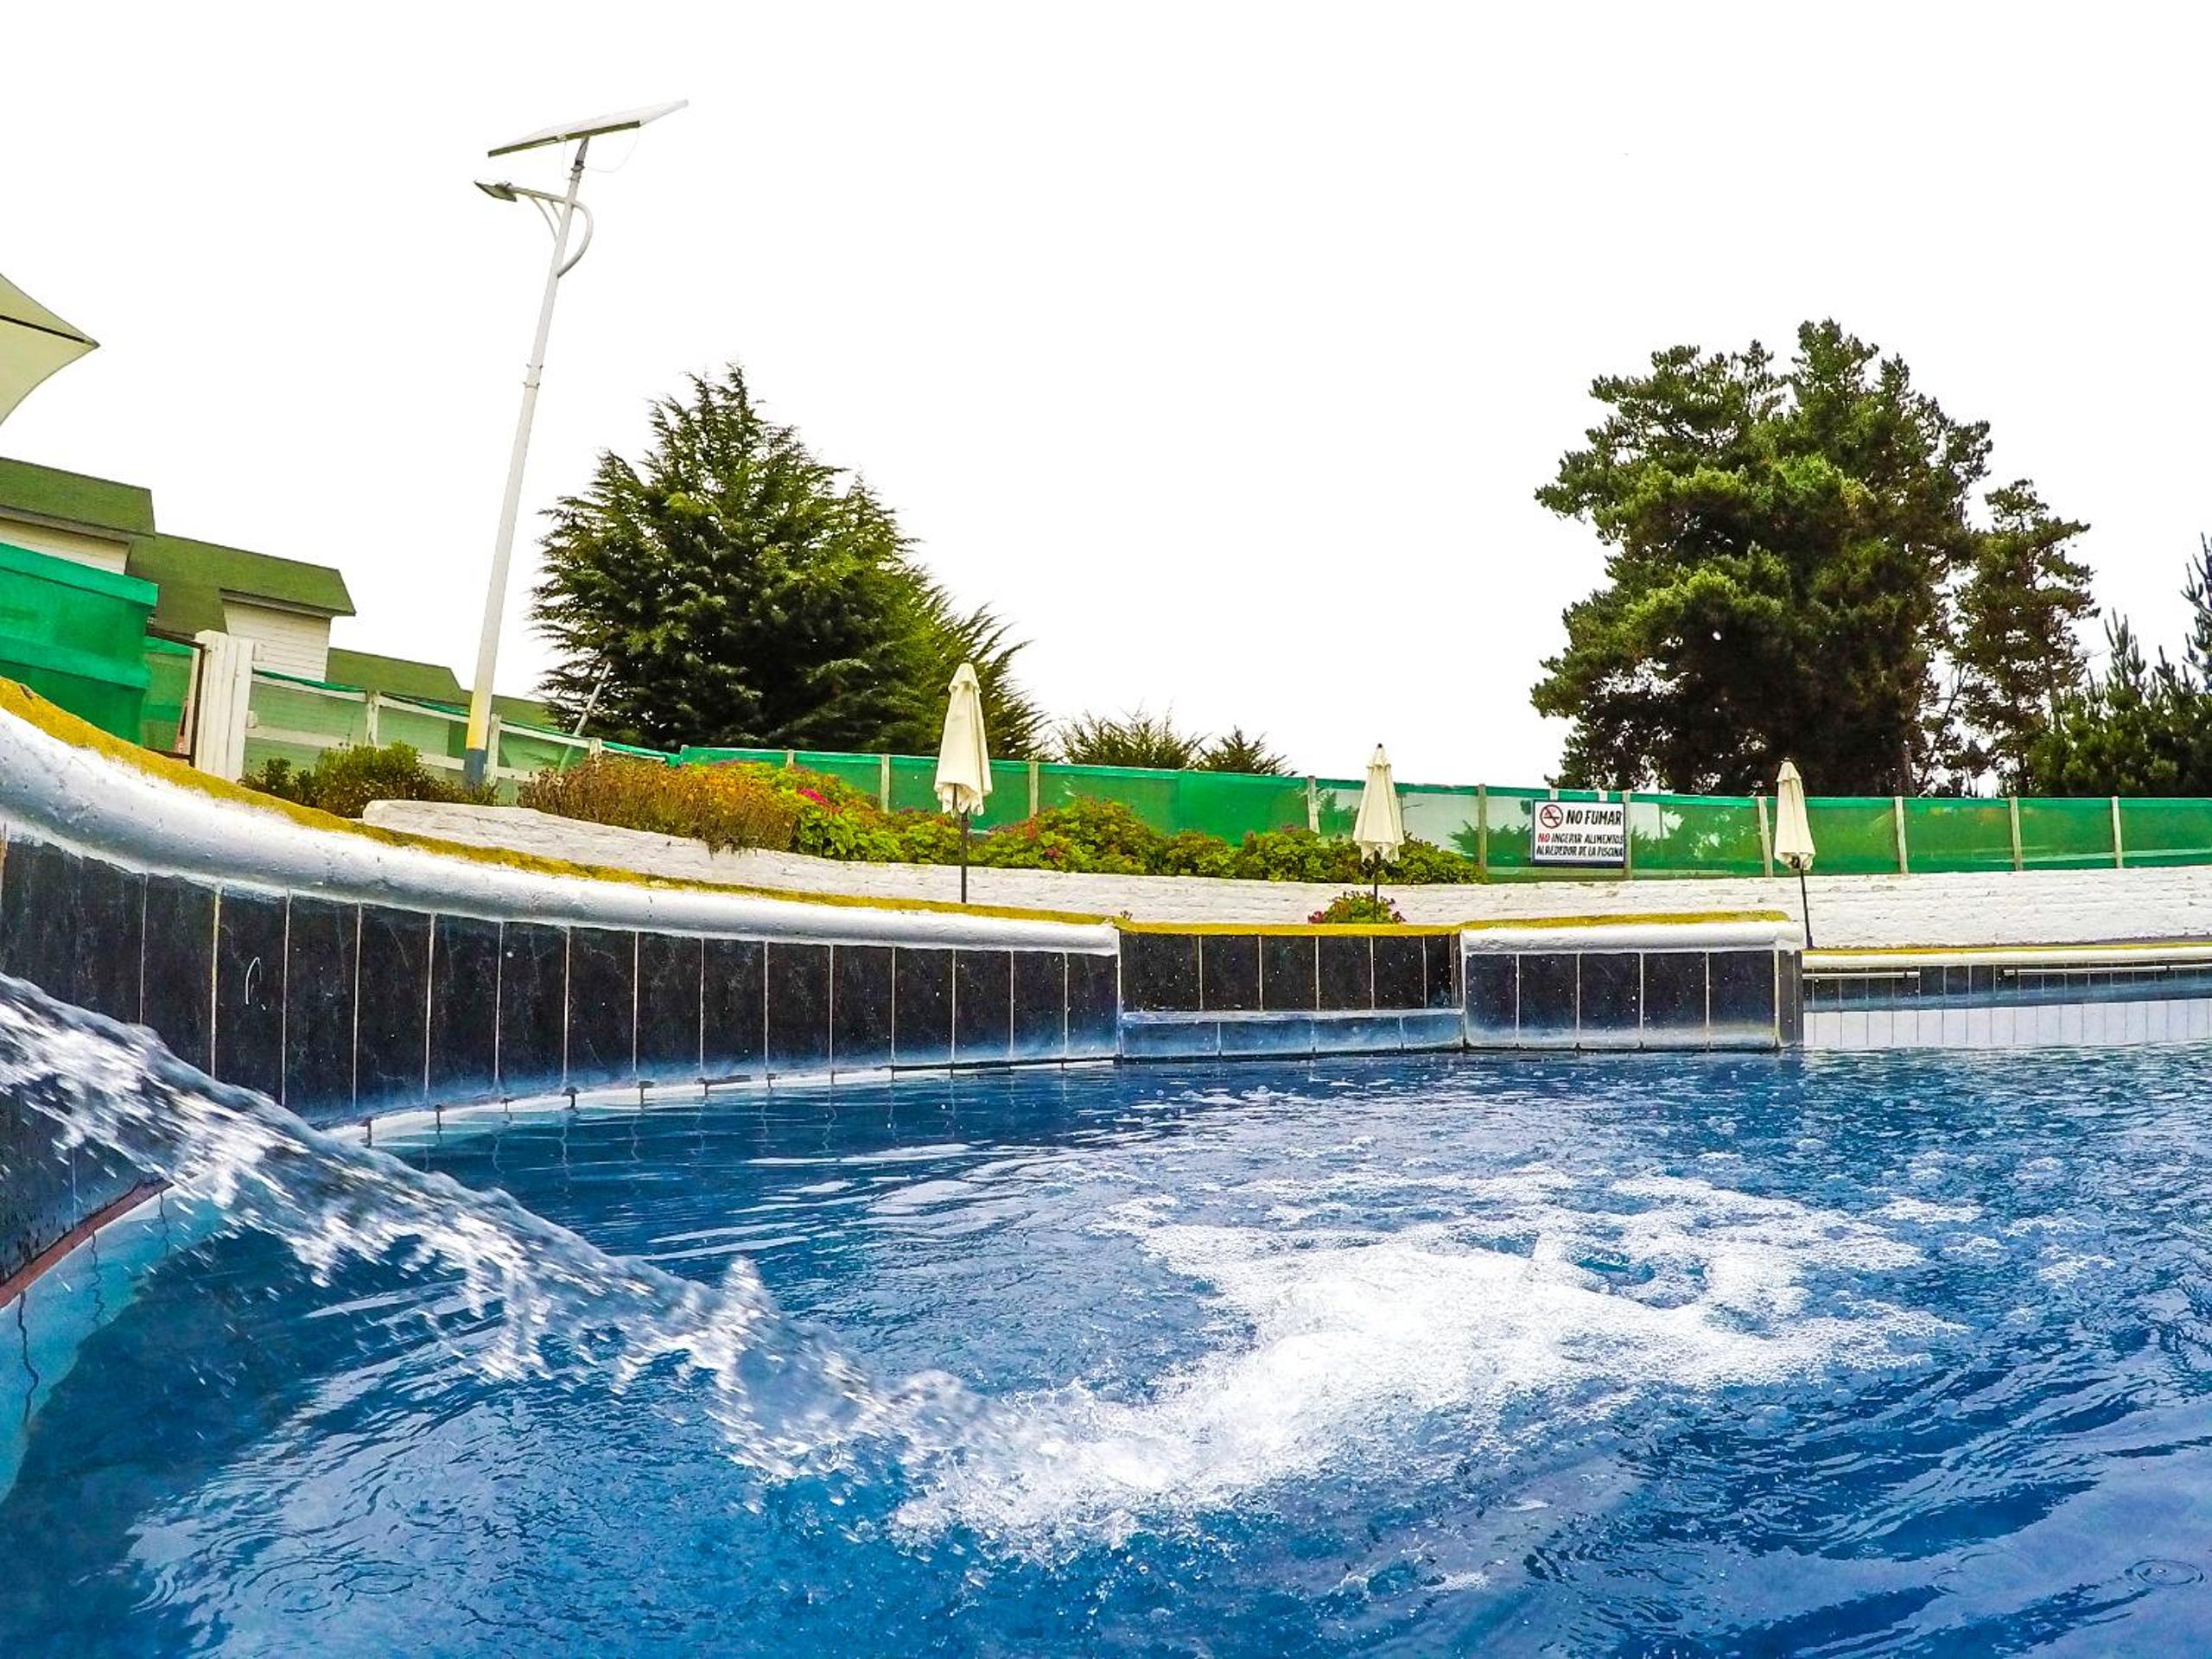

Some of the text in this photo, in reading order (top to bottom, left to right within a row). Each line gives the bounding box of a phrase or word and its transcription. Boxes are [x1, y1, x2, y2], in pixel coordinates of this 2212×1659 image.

[1566, 810, 1622, 825] NO FUMAR
[1538, 833, 1624, 844] NO INGERIR ALIMENTOS
[1578, 846, 1587, 856] DE
[1588, 846, 1596, 856] LA
[1597, 847, 1623, 857] PISCINA
